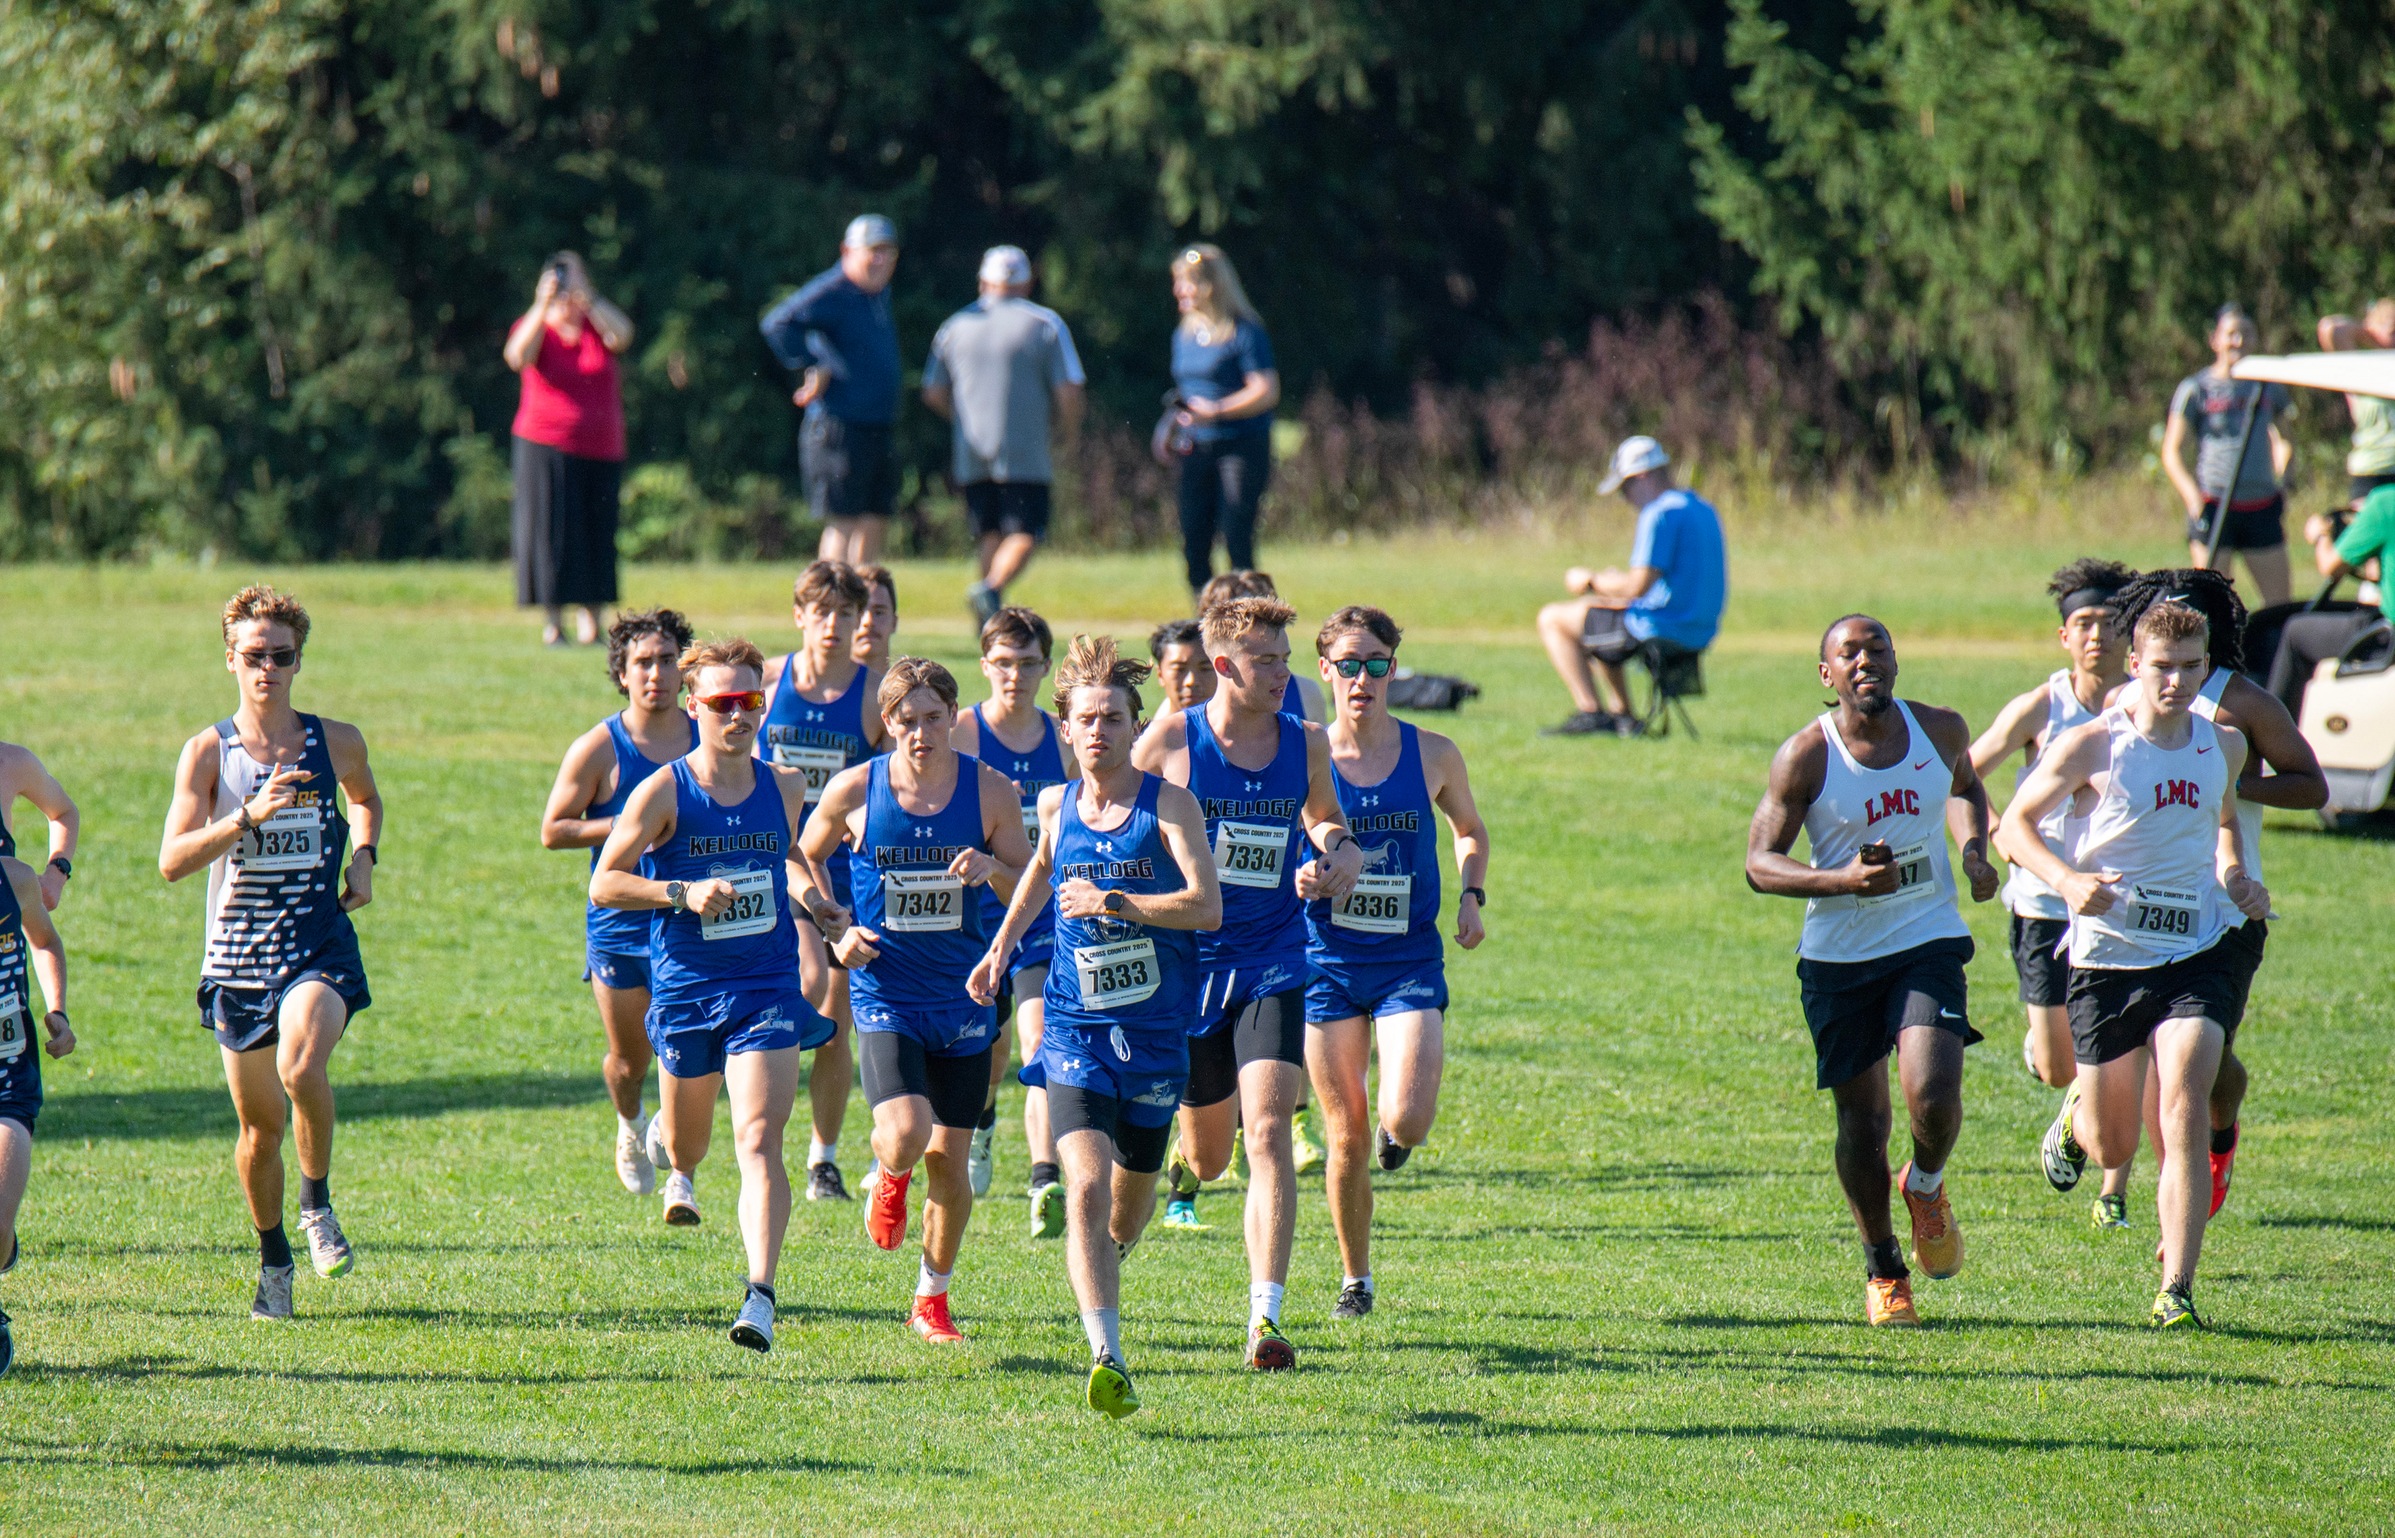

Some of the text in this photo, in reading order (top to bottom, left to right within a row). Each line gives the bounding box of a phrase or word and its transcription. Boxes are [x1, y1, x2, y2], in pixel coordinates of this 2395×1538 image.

[767, 724, 858, 757] KELLOGG
[2155, 779, 2200, 811] LMC
[300, 812, 314, 820] 2025
[1206, 798, 1296, 820] KELLOGG
[1865, 789, 1920, 827] LMC
[1251, 829, 1272, 838] COUNTRY
[1273, 831, 1284, 839] 2025
[1347, 810, 1419, 834] LLOGG
[689, 831, 779, 857] KELLOGG
[1062, 857, 1155, 882] KELLOGG
[1225, 844, 1277, 873] 7334
[753, 875, 767, 883] 2025
[896, 891, 952, 916] 7342
[2164, 891, 2184, 900] COUNTRY
[2185, 893, 2196, 901] 2025
[2137, 905, 2190, 934] 7349
[1089, 942, 1148, 959] CROSS COUNTRY 2025
[1087, 960, 1149, 994] 7333
